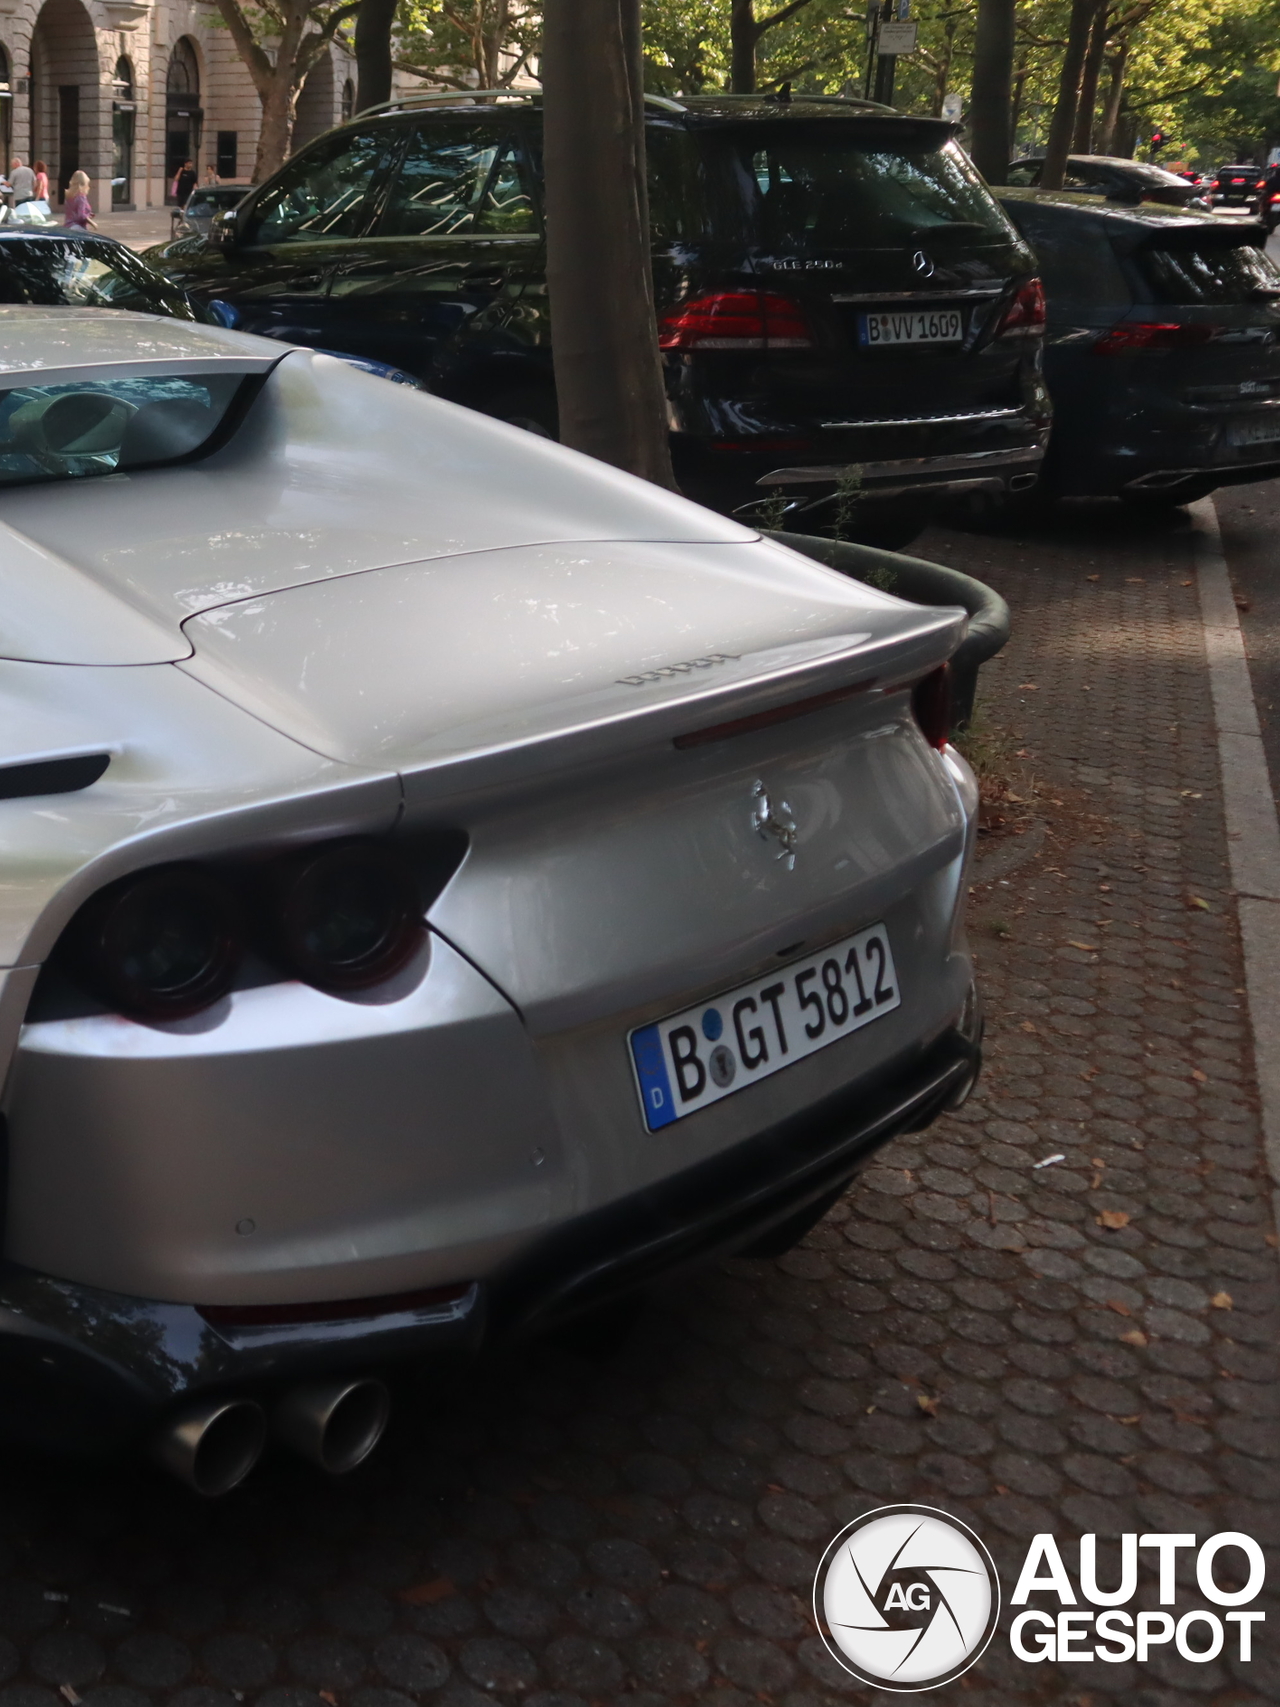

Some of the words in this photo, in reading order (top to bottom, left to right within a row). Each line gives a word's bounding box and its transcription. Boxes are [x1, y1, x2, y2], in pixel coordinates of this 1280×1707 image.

[773, 261, 801, 270] GLE
[868, 317, 881, 342] B
[891, 315, 914, 340] VV
[918, 313, 959, 339] 1609
[668, 1025, 707, 1103] B
[732, 982, 789, 1070] GT
[794, 936, 895, 1040] 5812
[650, 1086, 664, 1109] D
